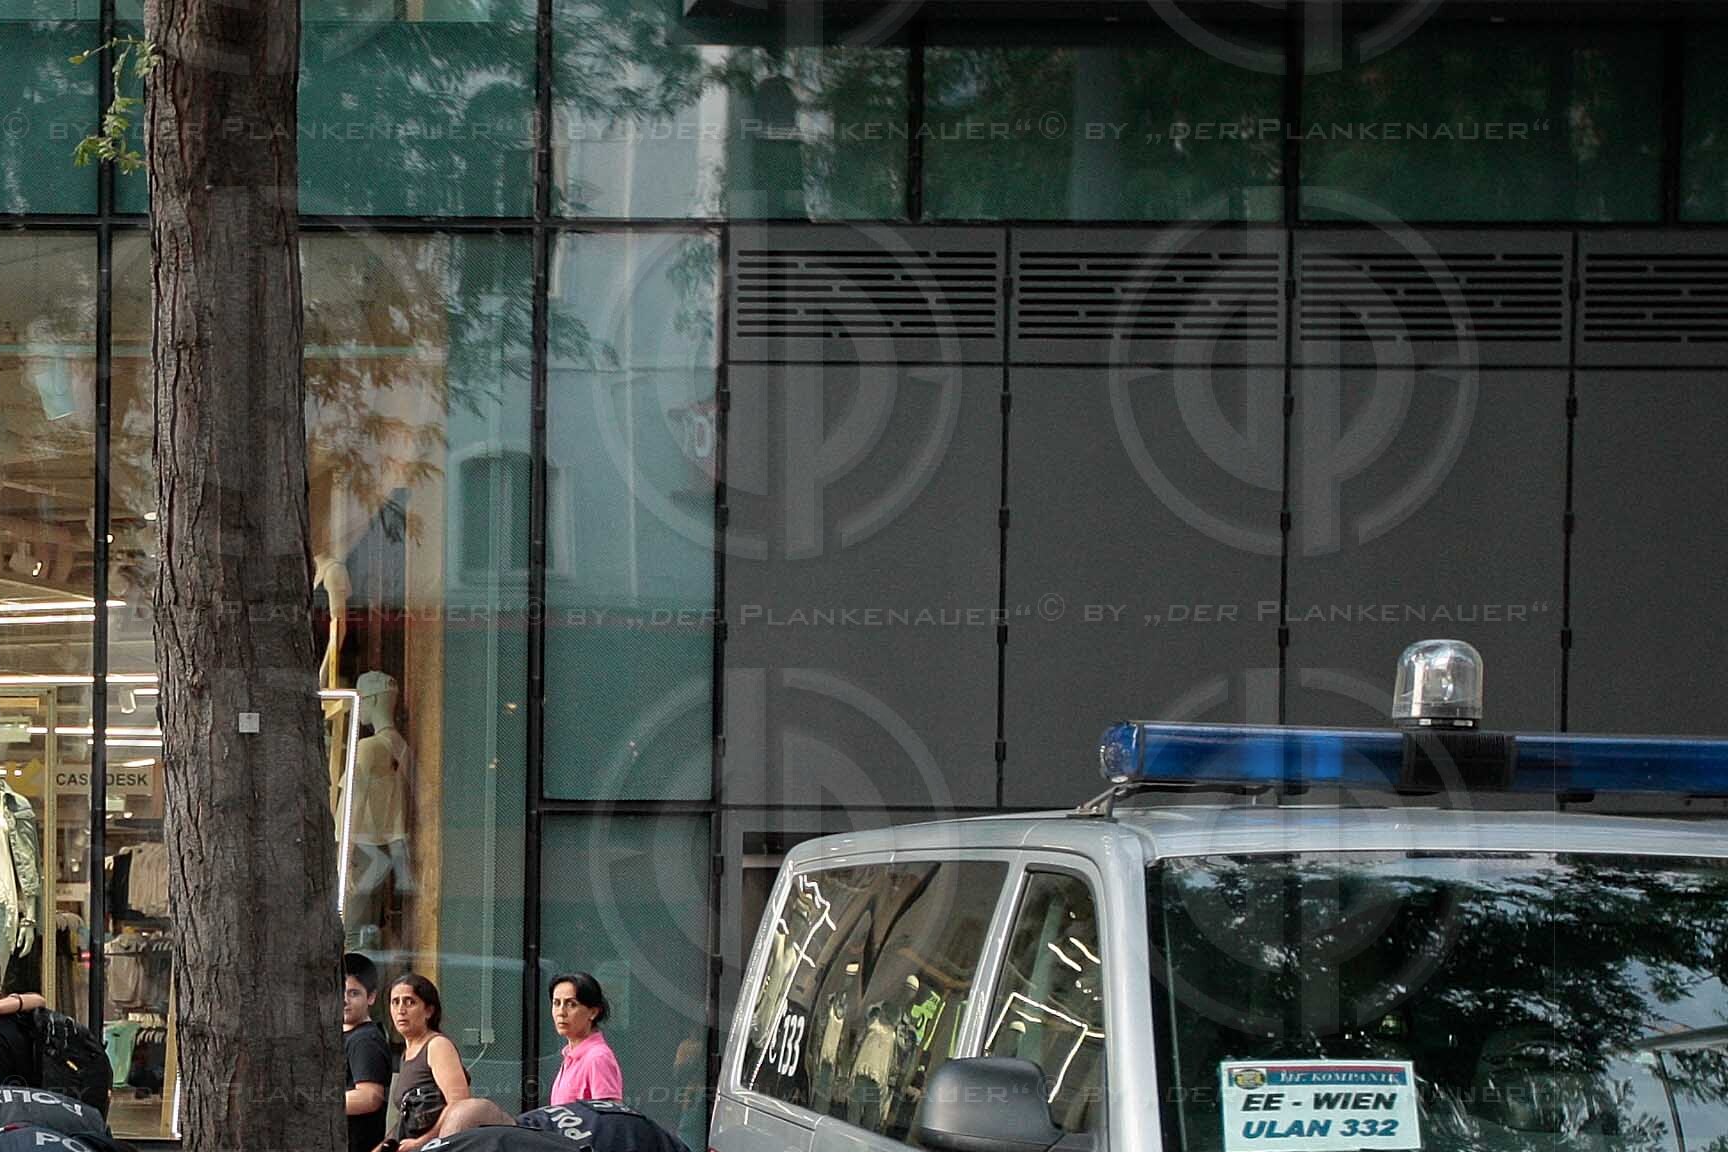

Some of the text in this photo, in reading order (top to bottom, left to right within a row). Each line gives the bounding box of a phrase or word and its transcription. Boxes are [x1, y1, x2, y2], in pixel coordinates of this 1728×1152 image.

[56, 773, 149, 786] CAS DESK
[778, 1014, 806, 1077] 133
[1241, 1093, 1285, 1112] EE
[1313, 1092, 1398, 1110] WIEN
[1242, 1118, 1400, 1139] ULAN 332
